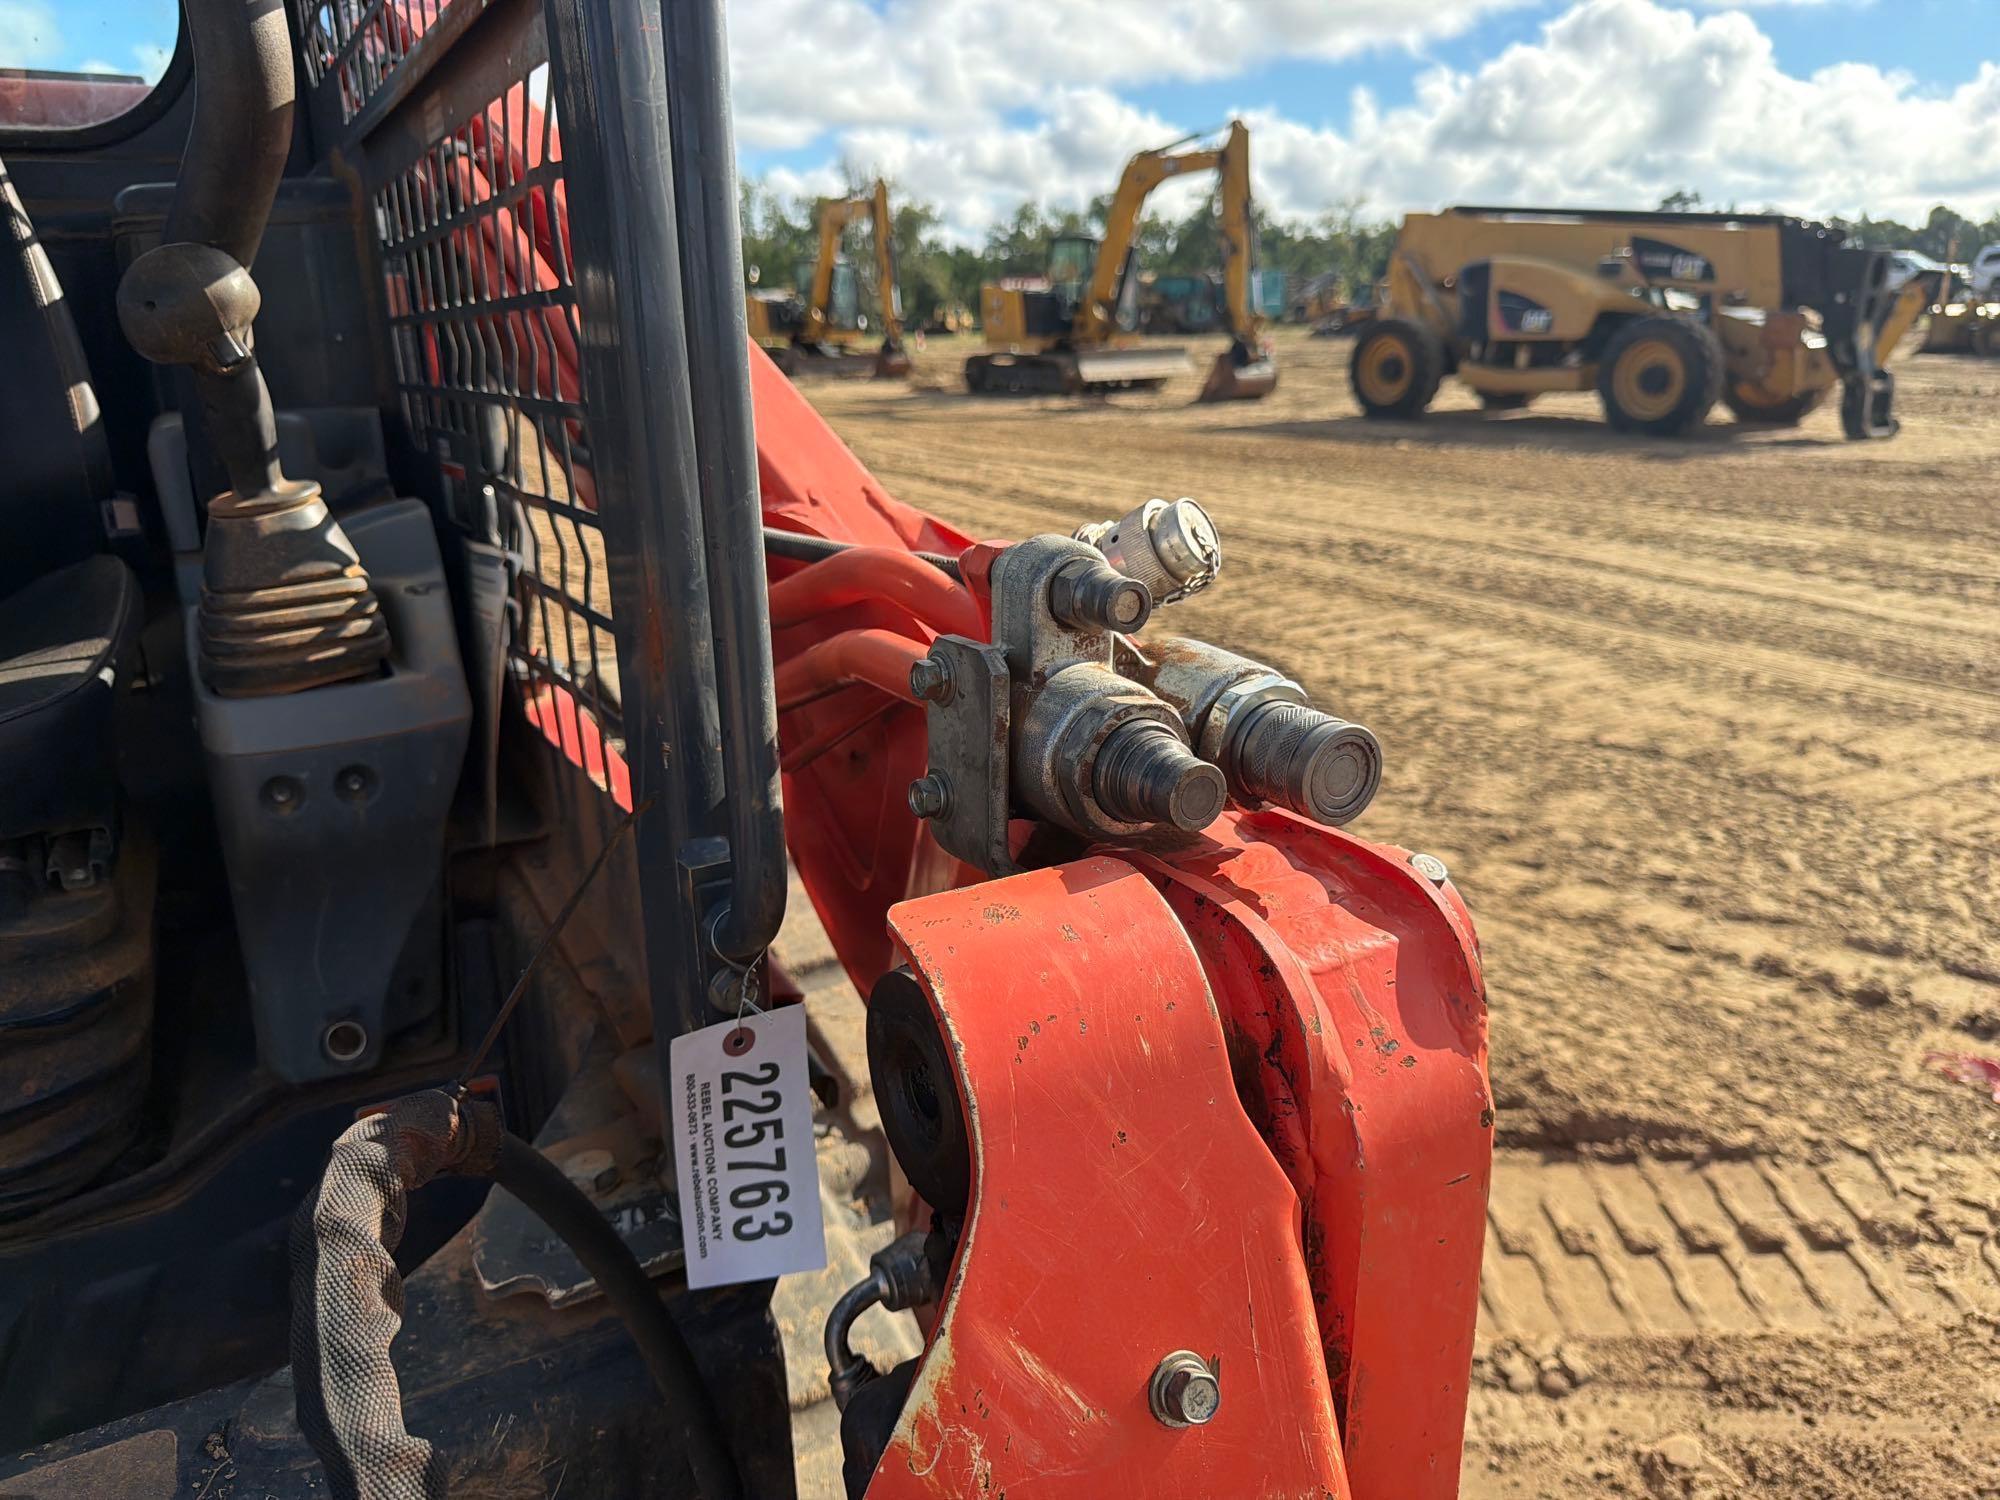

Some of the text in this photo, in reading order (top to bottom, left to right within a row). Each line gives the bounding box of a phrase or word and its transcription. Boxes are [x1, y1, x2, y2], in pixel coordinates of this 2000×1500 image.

[689, 1142, 707, 1258] www.rebelauction.com
[700, 1081, 723, 1241] REBEL AUCTION COMPANY
[721, 1062, 793, 1241] 225763
